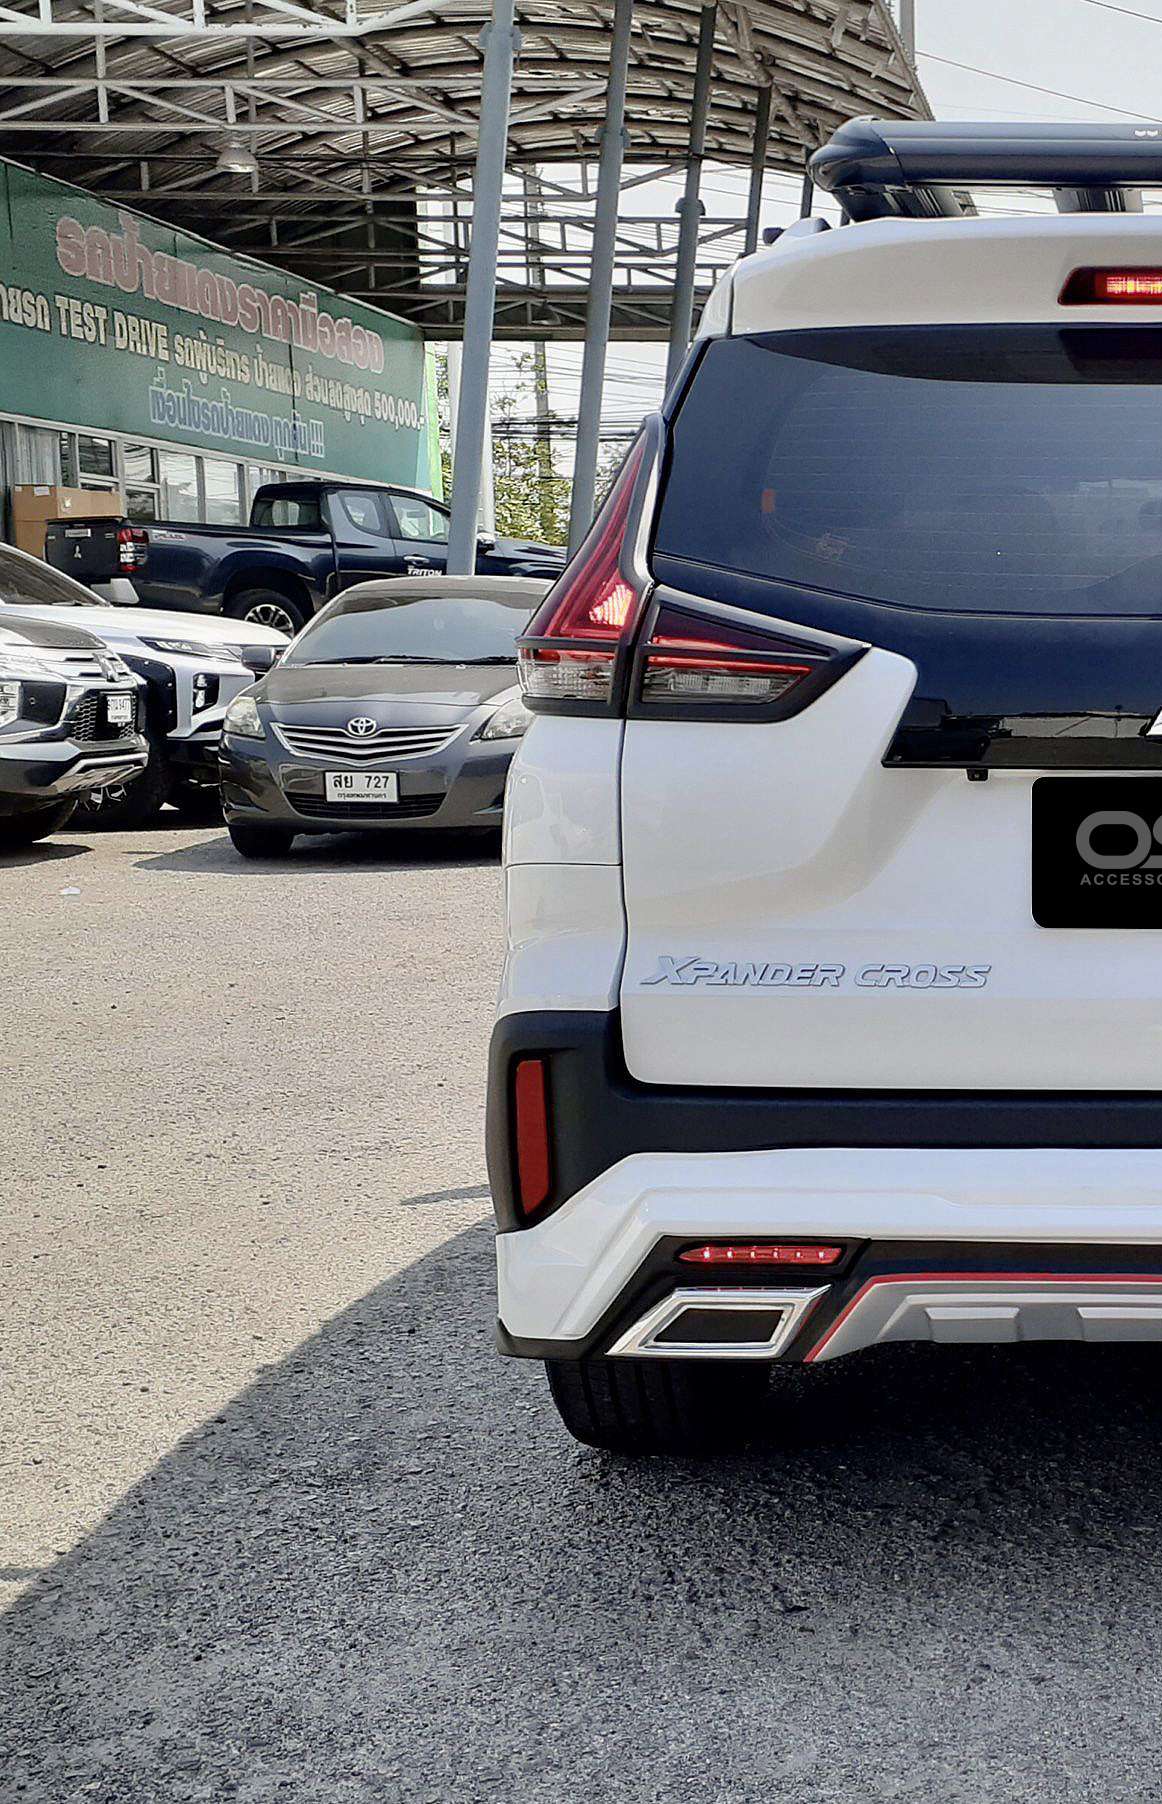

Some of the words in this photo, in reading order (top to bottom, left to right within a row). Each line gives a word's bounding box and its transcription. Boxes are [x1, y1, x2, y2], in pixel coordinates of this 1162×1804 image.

[56, 209, 384, 374] รถป้ายแดงราคามือสอง
[54, 294, 108, 346] TEST
[113, 310, 170, 361] DRIVE
[333, 775, 353, 788] สย
[365, 775, 390, 788] 727
[640, 955, 846, 987] XPANDER
[854, 964, 993, 988] CROSS
